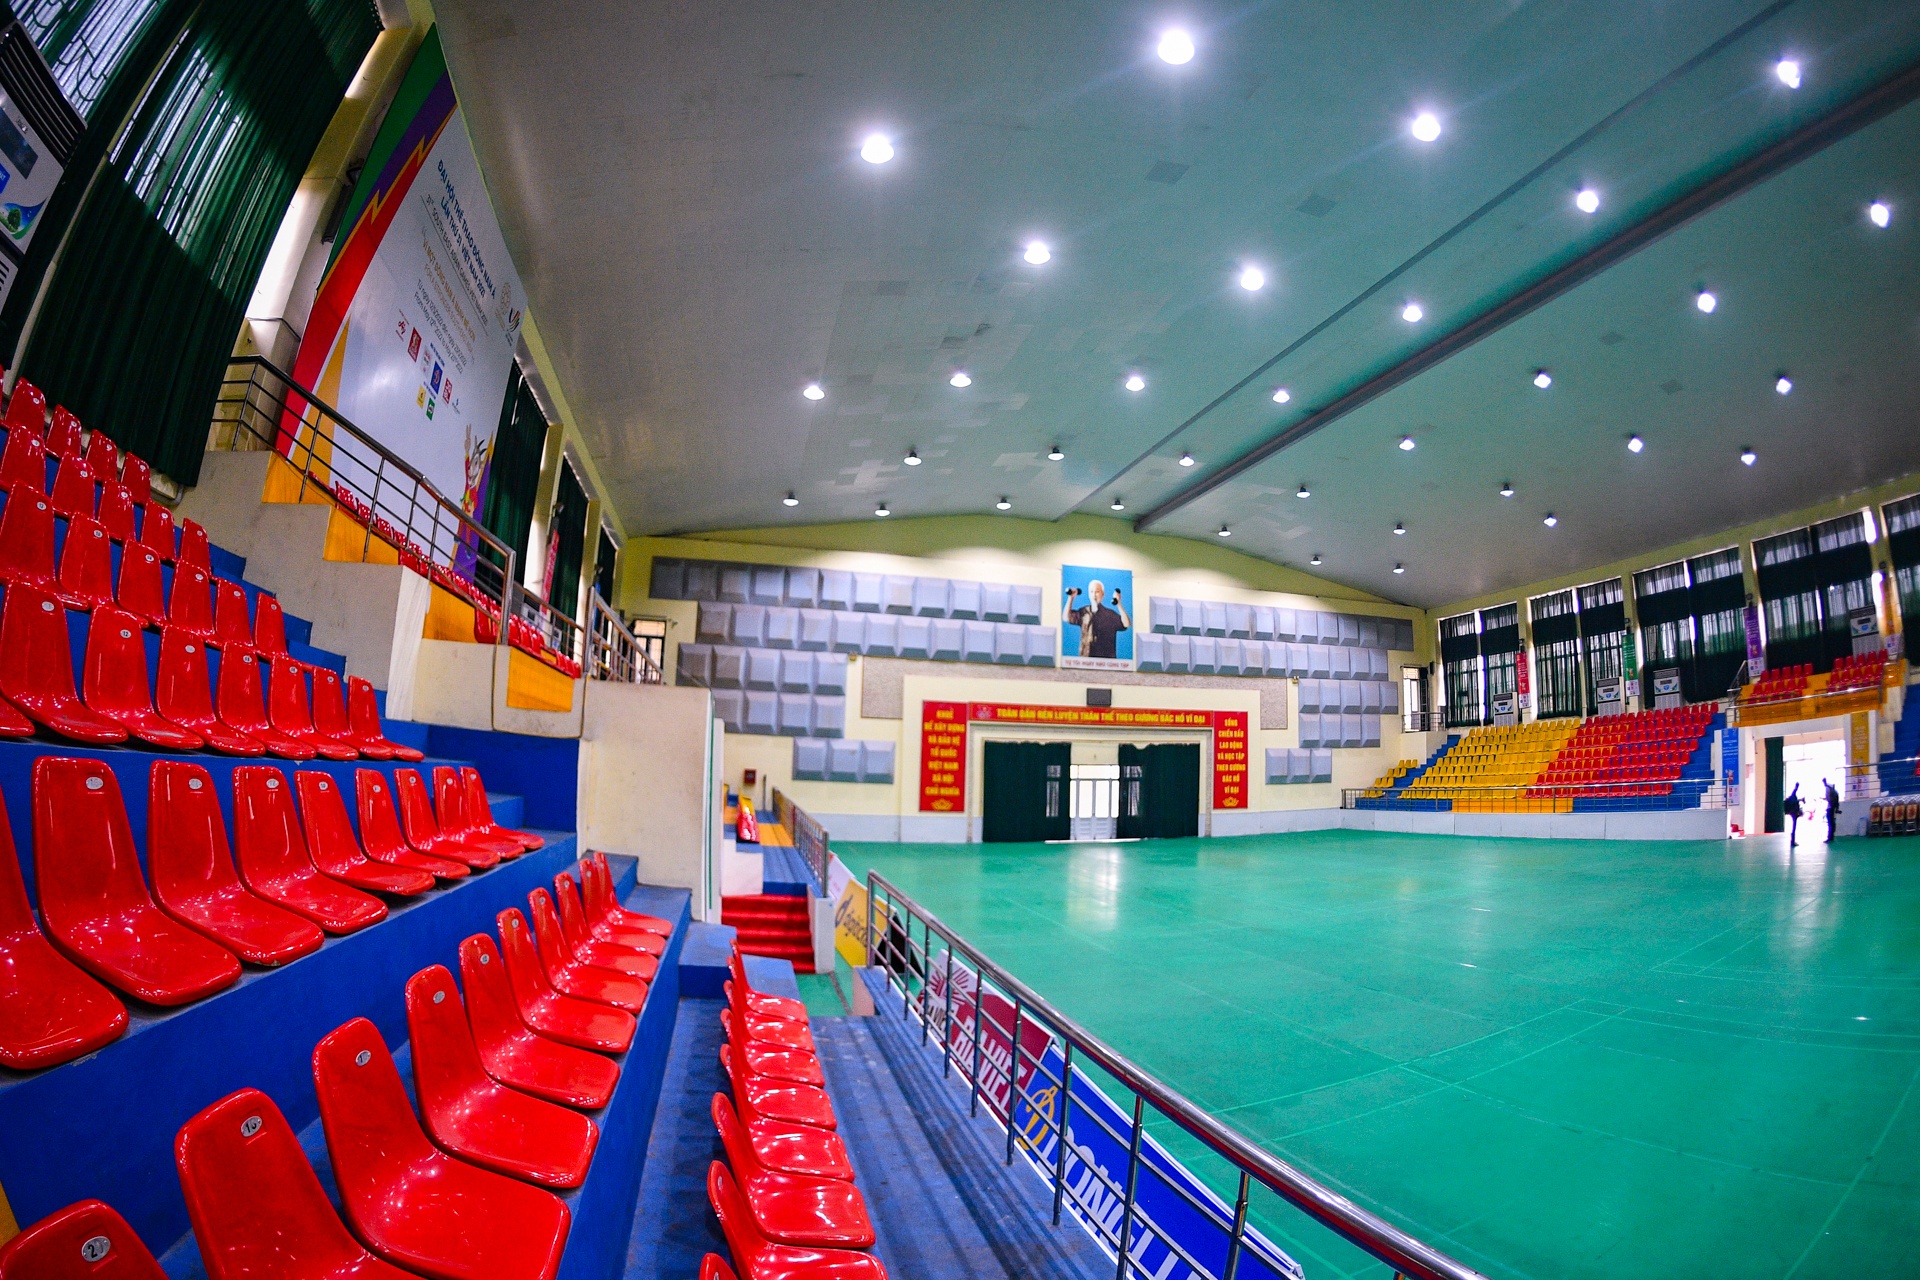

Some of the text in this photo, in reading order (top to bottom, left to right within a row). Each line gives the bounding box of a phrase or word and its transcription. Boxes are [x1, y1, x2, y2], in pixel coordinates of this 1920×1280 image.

[461, 220, 474, 248] THAO
[1116, 712, 1133, 721] THEO
[1219, 741, 1229, 749] LAO
[943, 761, 959, 771] NAM
[1216, 763, 1229, 772] THEO
[1222, 774, 1232, 783] BÁC
